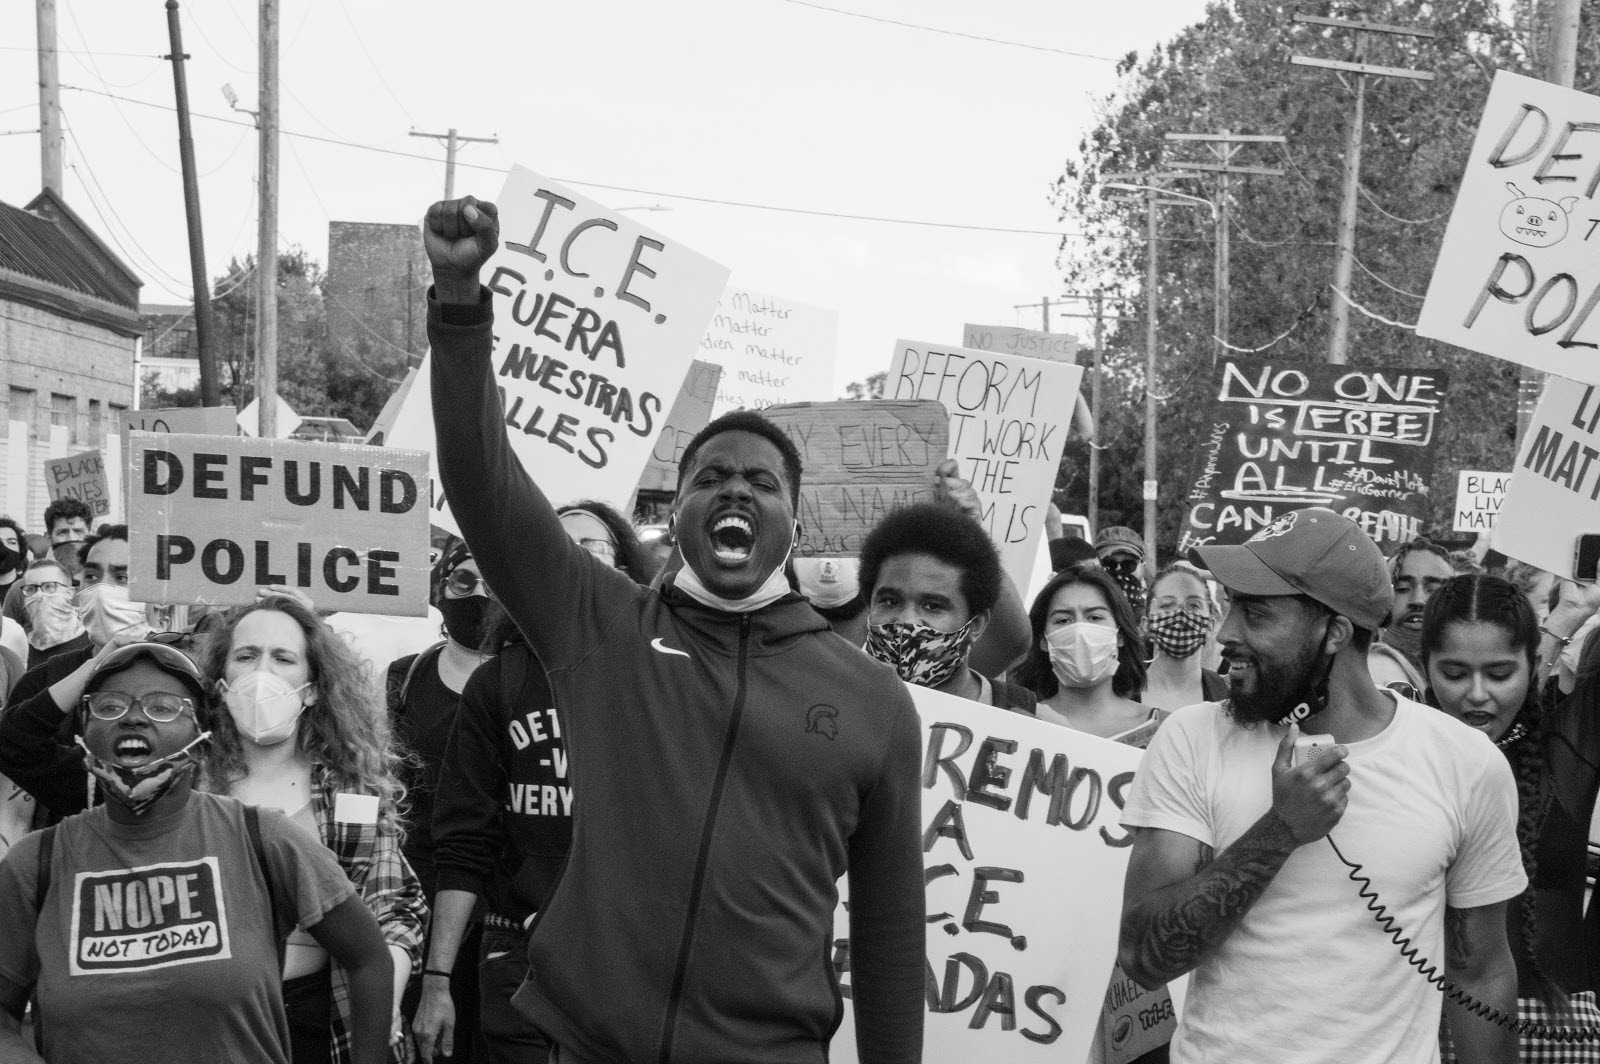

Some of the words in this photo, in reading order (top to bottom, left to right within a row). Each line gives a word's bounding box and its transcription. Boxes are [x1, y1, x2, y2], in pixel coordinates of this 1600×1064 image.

[505, 188, 667, 324] I.C.E.
[487, 266, 626, 368] FUERA
[714, 314, 772, 337] Matter
[733, 293, 792, 319] Matter
[1006, 333, 1074, 354] JUSTICE
[499, 343, 662, 437] NUESTRAS
[894, 348, 1041, 418] REFORM
[1218, 362, 1310, 402] NO
[1333, 372, 1440, 403] ONE
[497, 386, 615, 469] LLES
[982, 419, 1057, 462] WORK
[1249, 404, 1286, 429] IS
[1309, 408, 1423, 440] FREE
[839, 422, 934, 467] EVERY
[1237, 432, 1394, 466] UNTIL
[51, 457, 104, 484] BLACK
[142, 448, 418, 514] DEFUND
[966, 457, 1020, 494] THE
[1234, 461, 1340, 493] ALL
[1004, 503, 1036, 544] IS
[1190, 503, 1272, 532] CAN
[1459, 510, 1500, 529] MAT
[155, 534, 400, 596] POLICE
[505, 783, 574, 817] VERY
[94, 873, 203, 932] NOPE
[87, 938, 138, 958] NOT
[142, 925, 211, 955] TODAY
